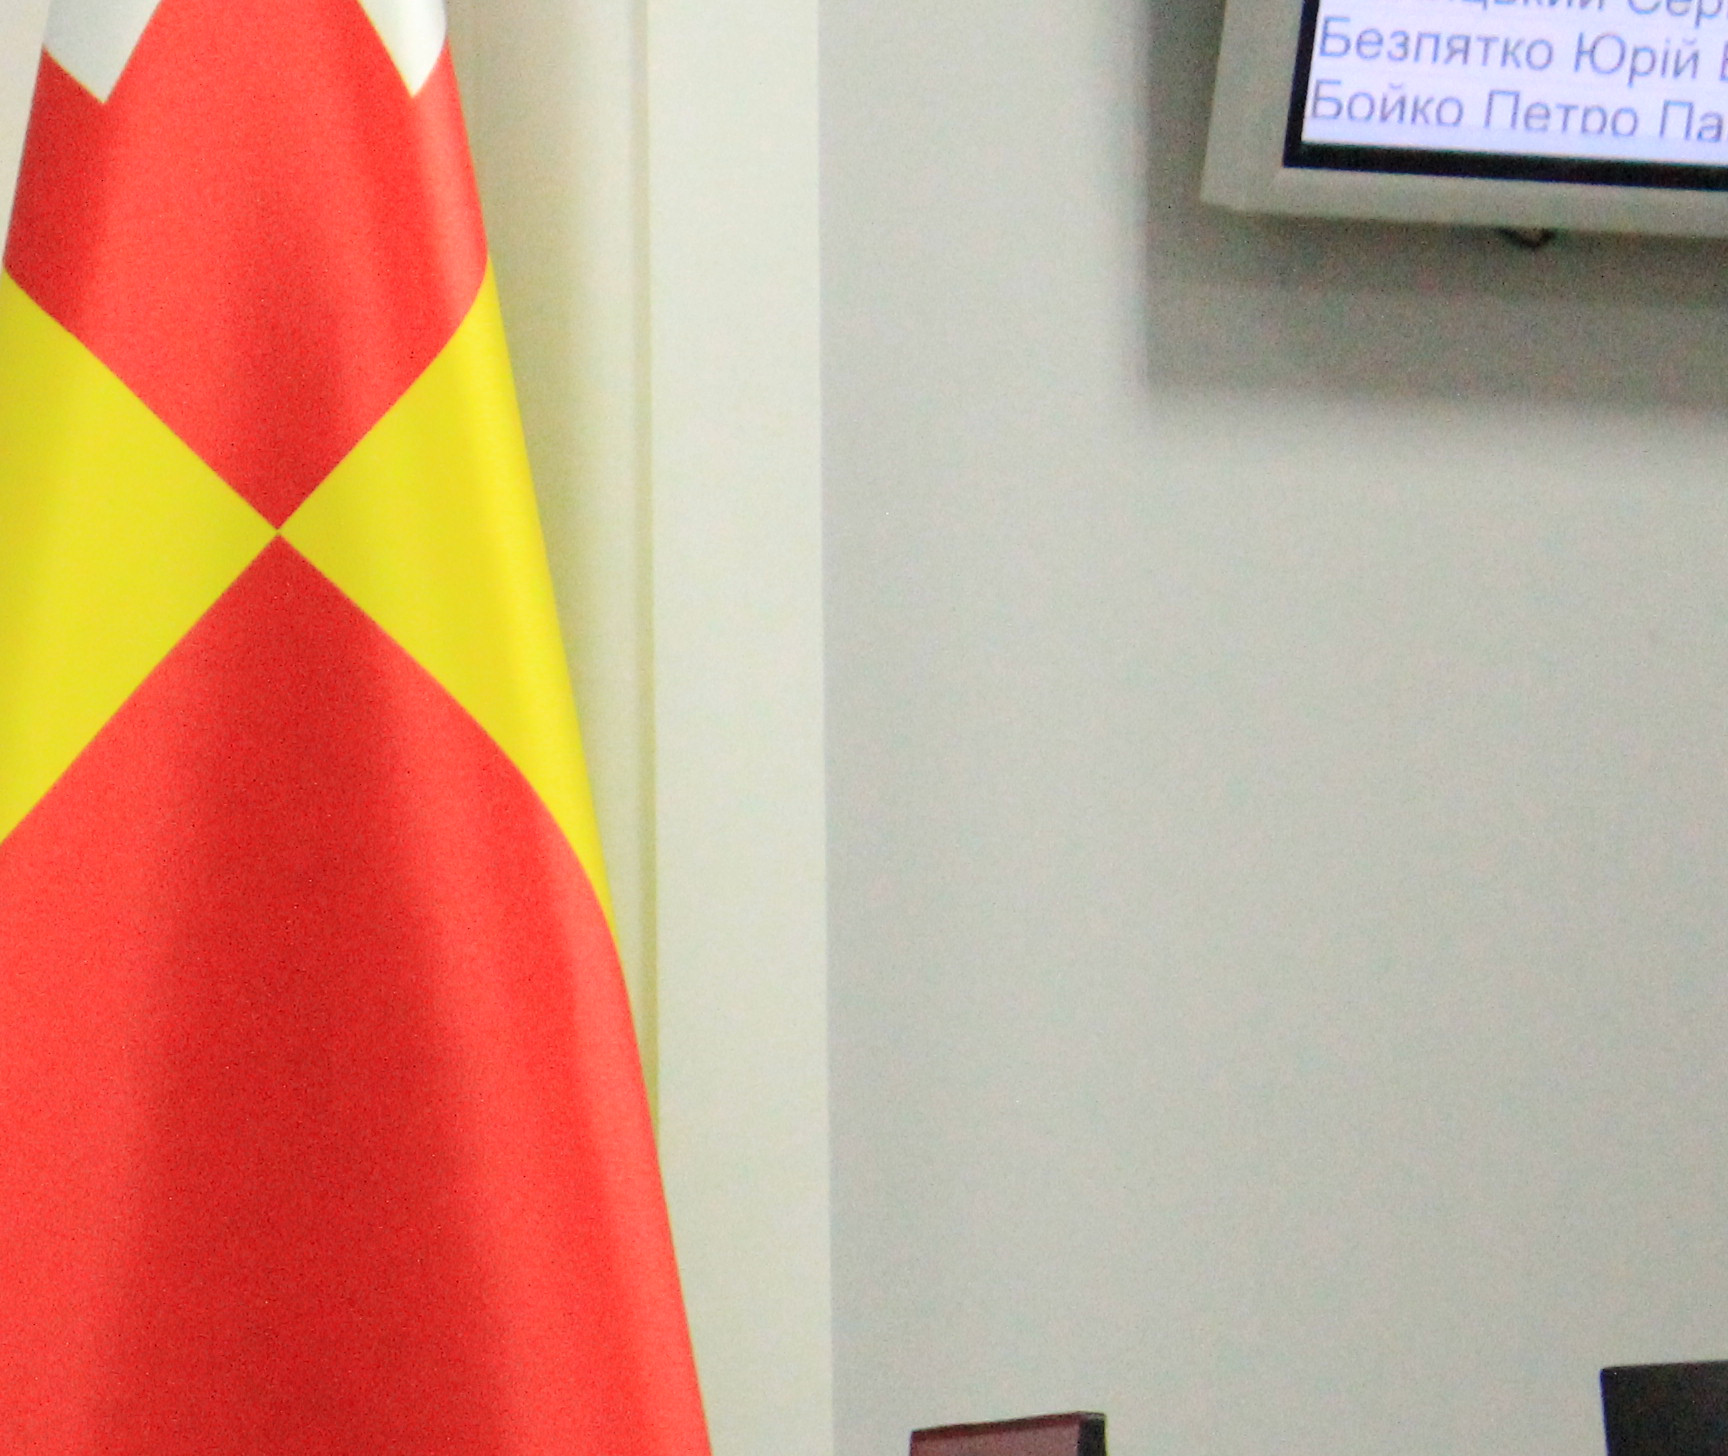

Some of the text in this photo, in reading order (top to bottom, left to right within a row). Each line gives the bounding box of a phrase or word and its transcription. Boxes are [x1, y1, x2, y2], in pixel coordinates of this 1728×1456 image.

[1319, 16, 1553, 69] Безпятко
[1574, 32, 1700, 88] Юрій
[1311, 79, 1464, 127] Бойко
[1484, 89, 1638, 137] Петро
